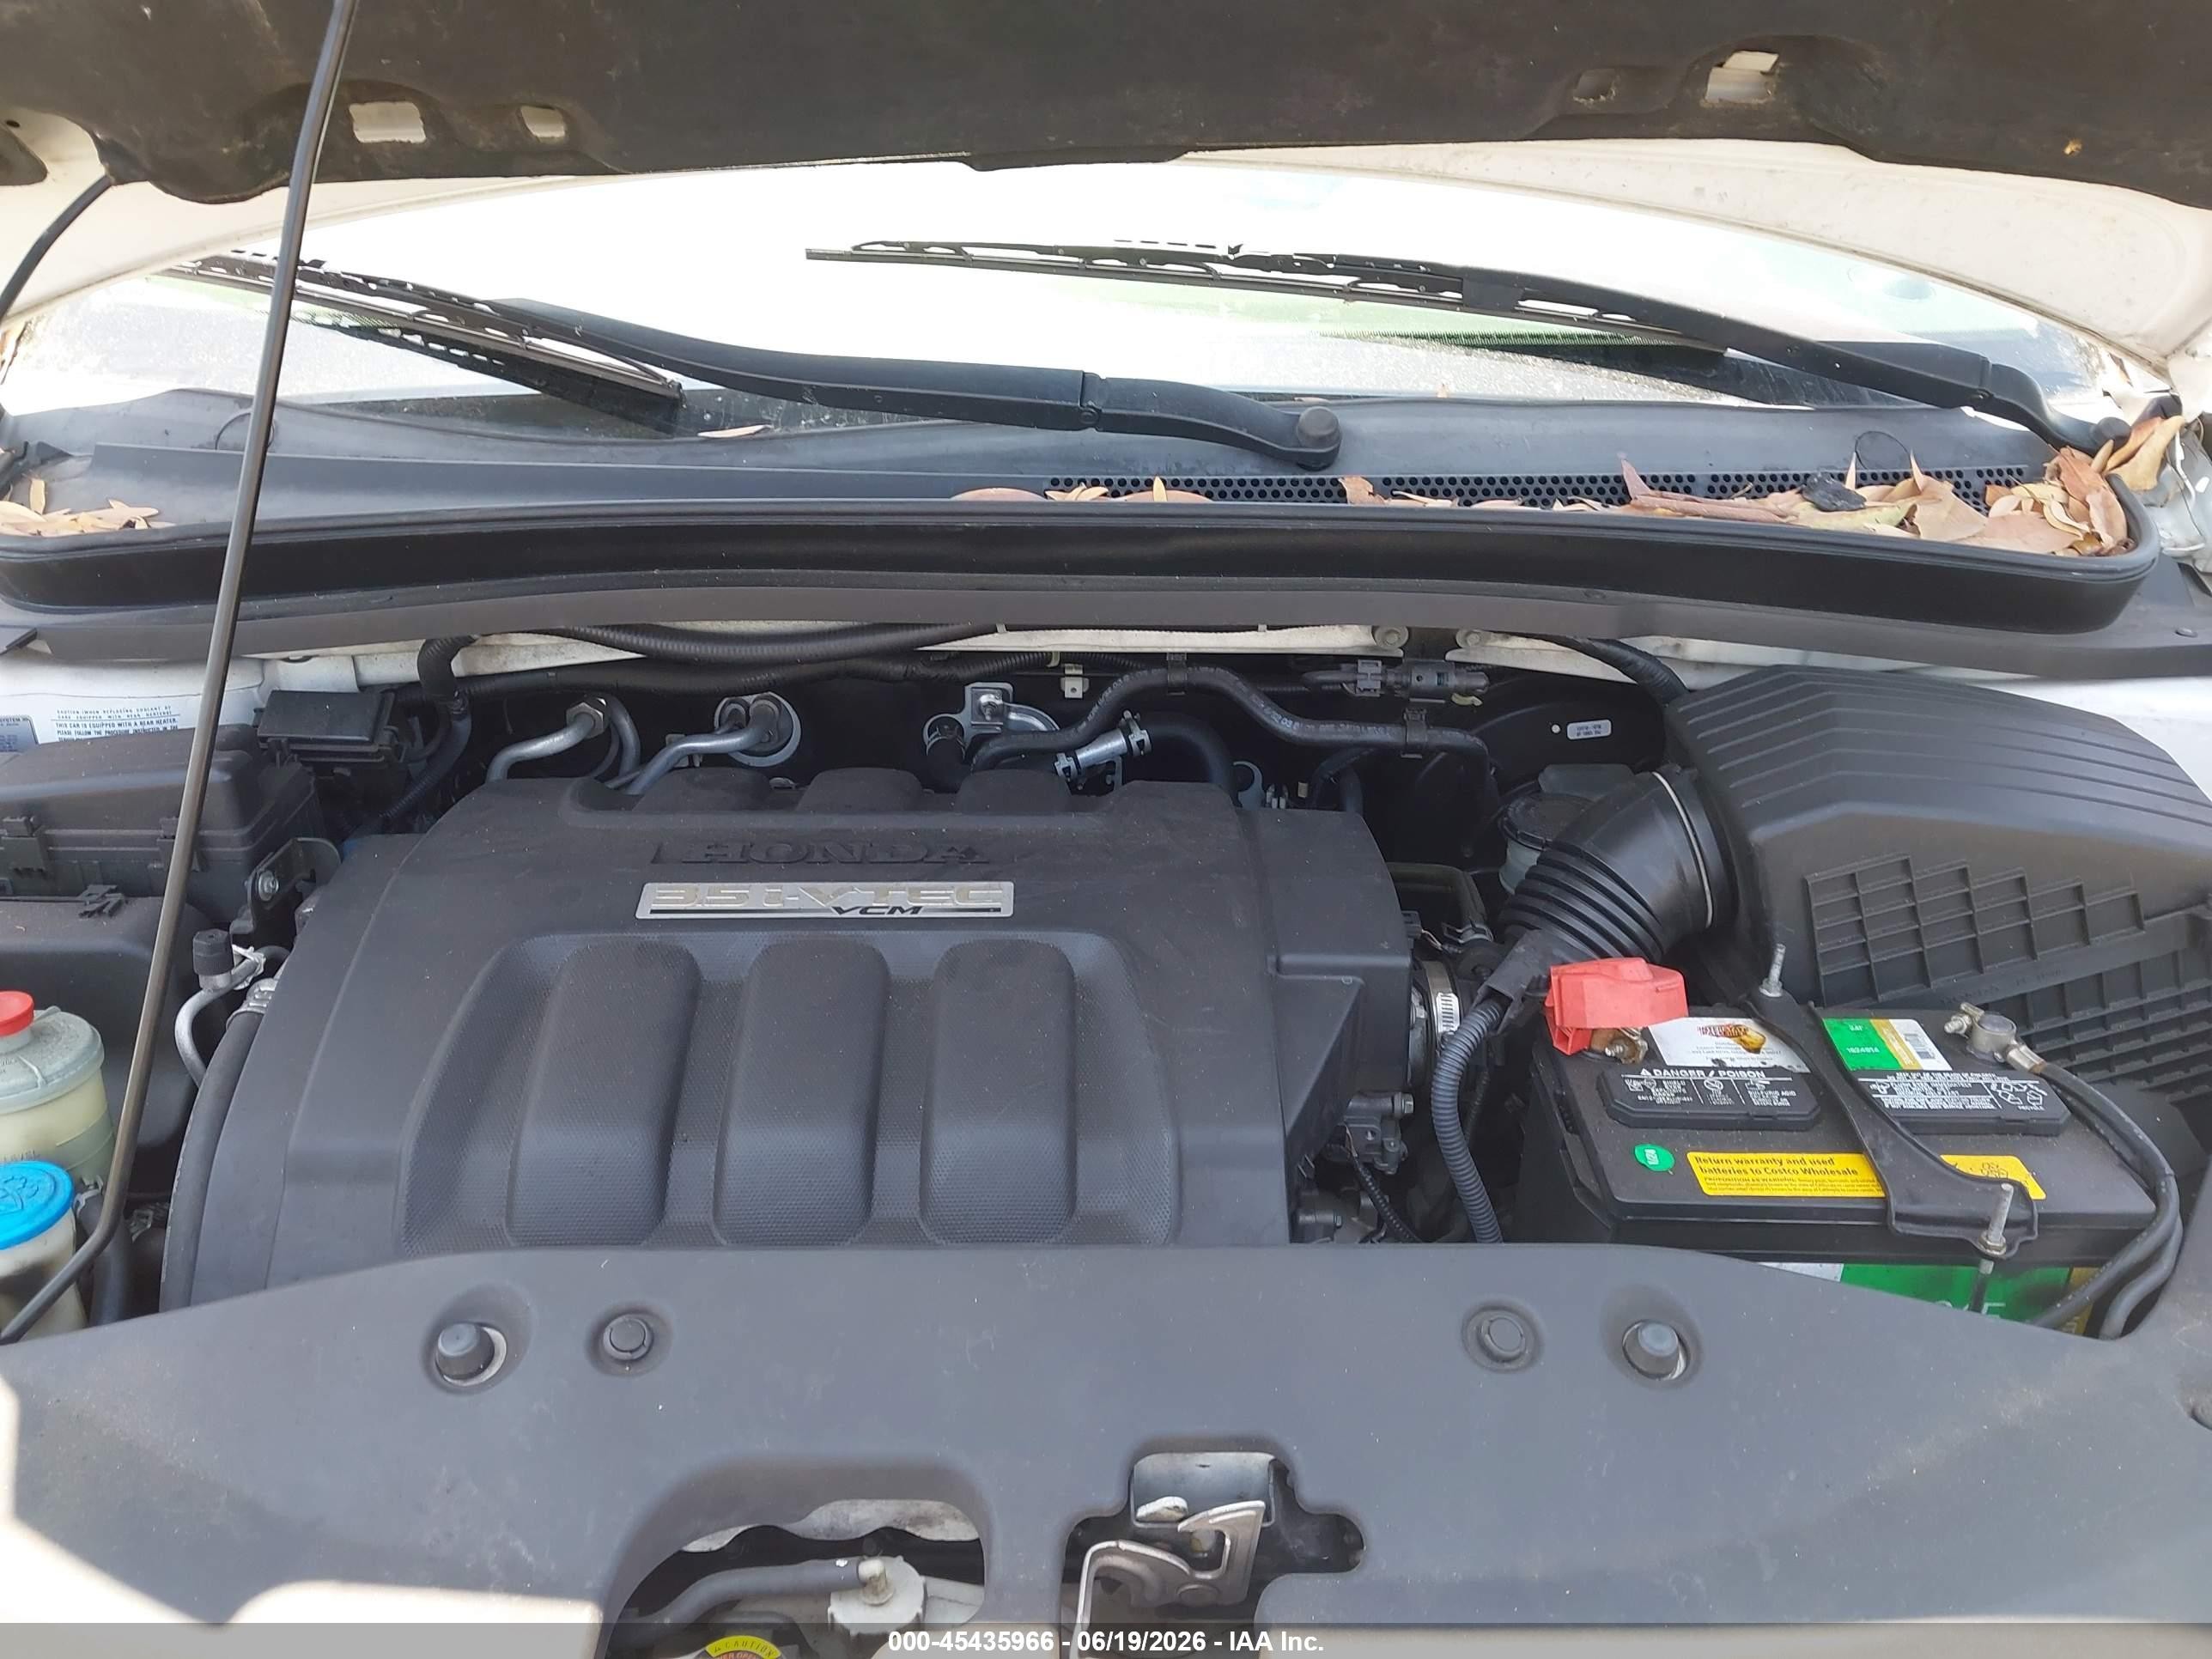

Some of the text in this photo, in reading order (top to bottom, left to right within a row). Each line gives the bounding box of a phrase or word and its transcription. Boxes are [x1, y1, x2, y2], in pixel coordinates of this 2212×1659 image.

[681, 841, 990, 864] HONDA
[832, 906, 923, 915] VCM
[1653, 1069, 1706, 1079] DANGER
[1718, 1070, 1766, 1079] POISON
[1695, 1156, 1835, 1166] Return warranty and used
[1699, 1165, 1748, 1175] batteries
[1801, 1167, 1858, 1176] Wholesale
